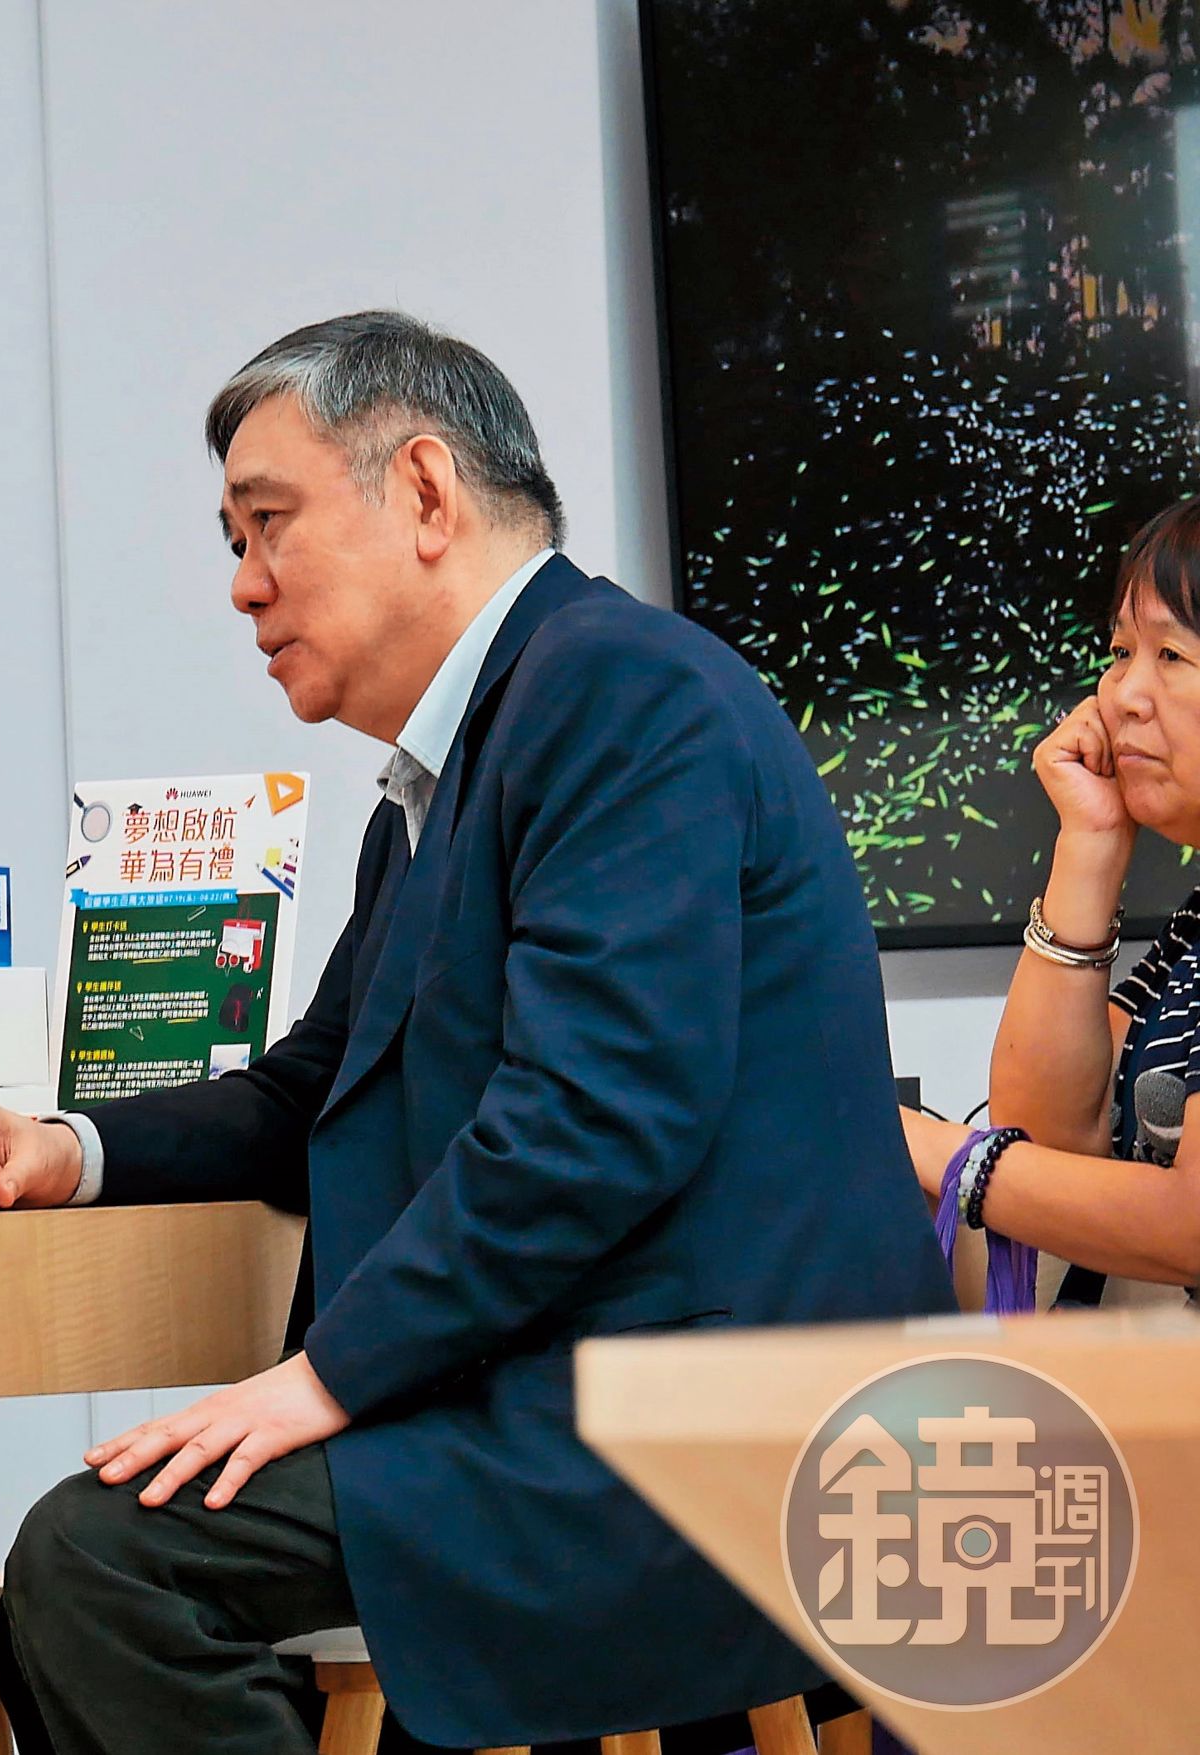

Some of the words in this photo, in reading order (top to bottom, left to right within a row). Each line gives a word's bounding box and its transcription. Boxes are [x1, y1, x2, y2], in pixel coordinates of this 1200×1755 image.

[180, 790, 212, 799] HUAWEI
[120, 845, 234, 883] 華為有禮
